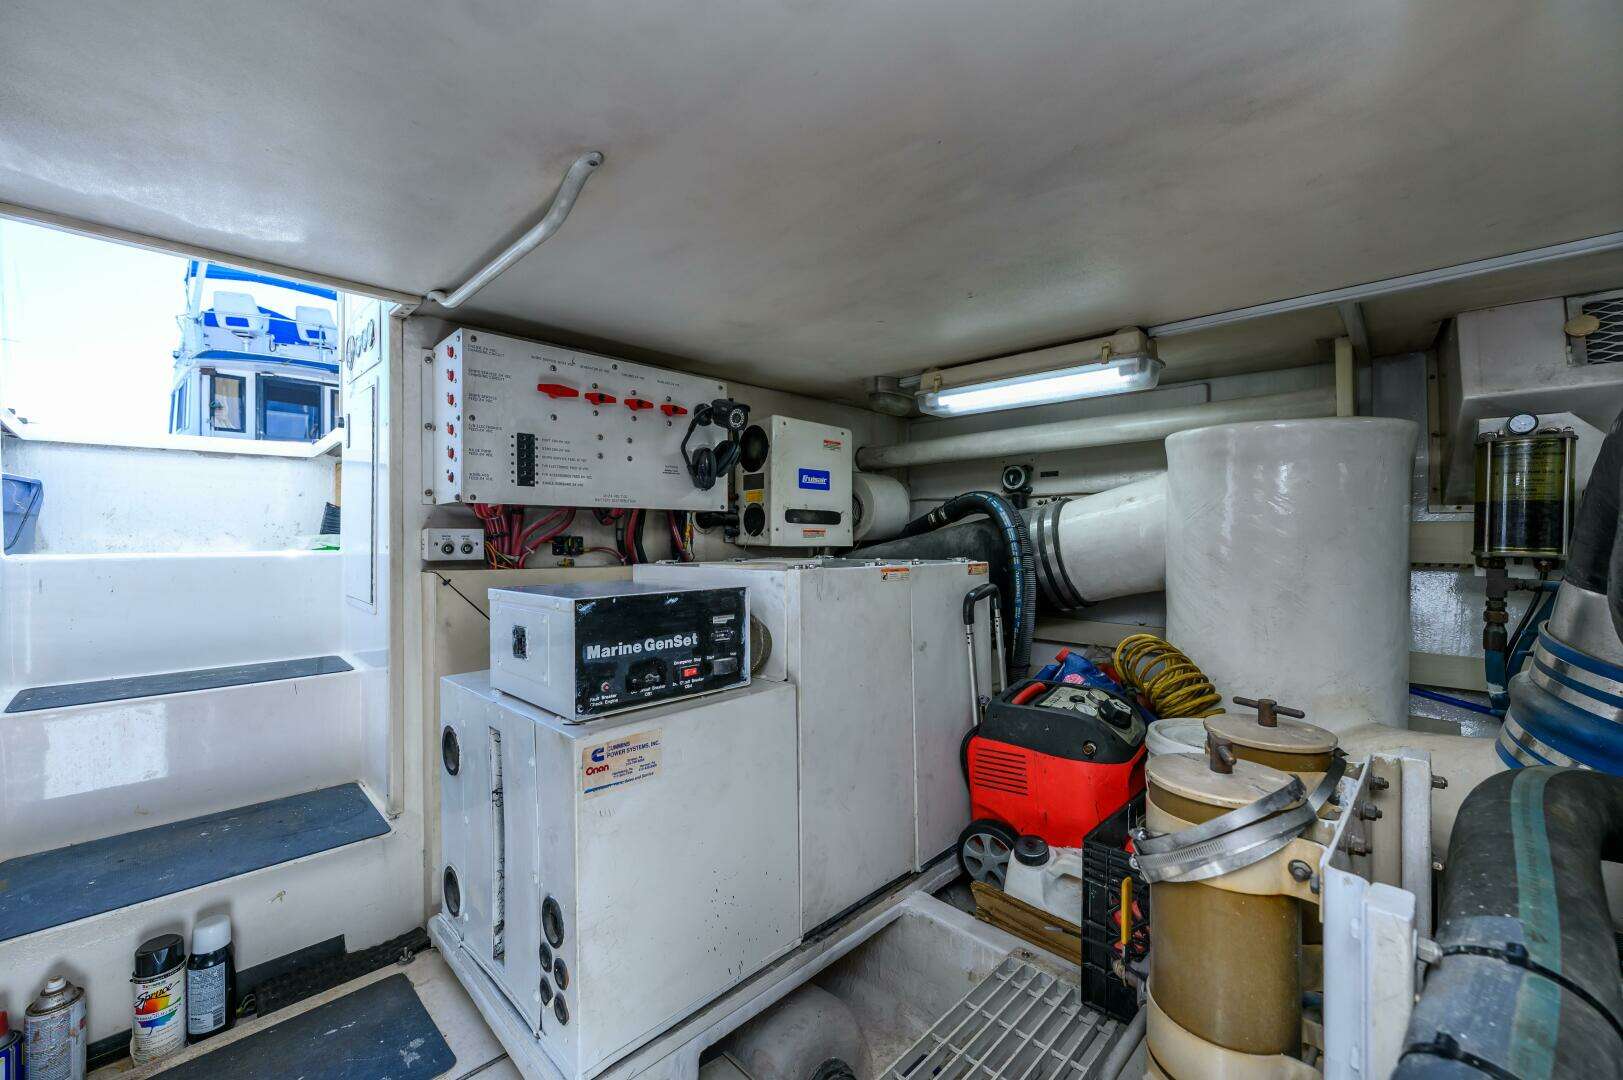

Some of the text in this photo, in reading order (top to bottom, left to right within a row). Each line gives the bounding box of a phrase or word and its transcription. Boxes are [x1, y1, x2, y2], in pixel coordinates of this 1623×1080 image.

[586, 642, 642, 660] Marine
[644, 632, 698, 652] GenSet
[607, 749, 626, 758] POWER
[586, 764, 609, 776] Onan
